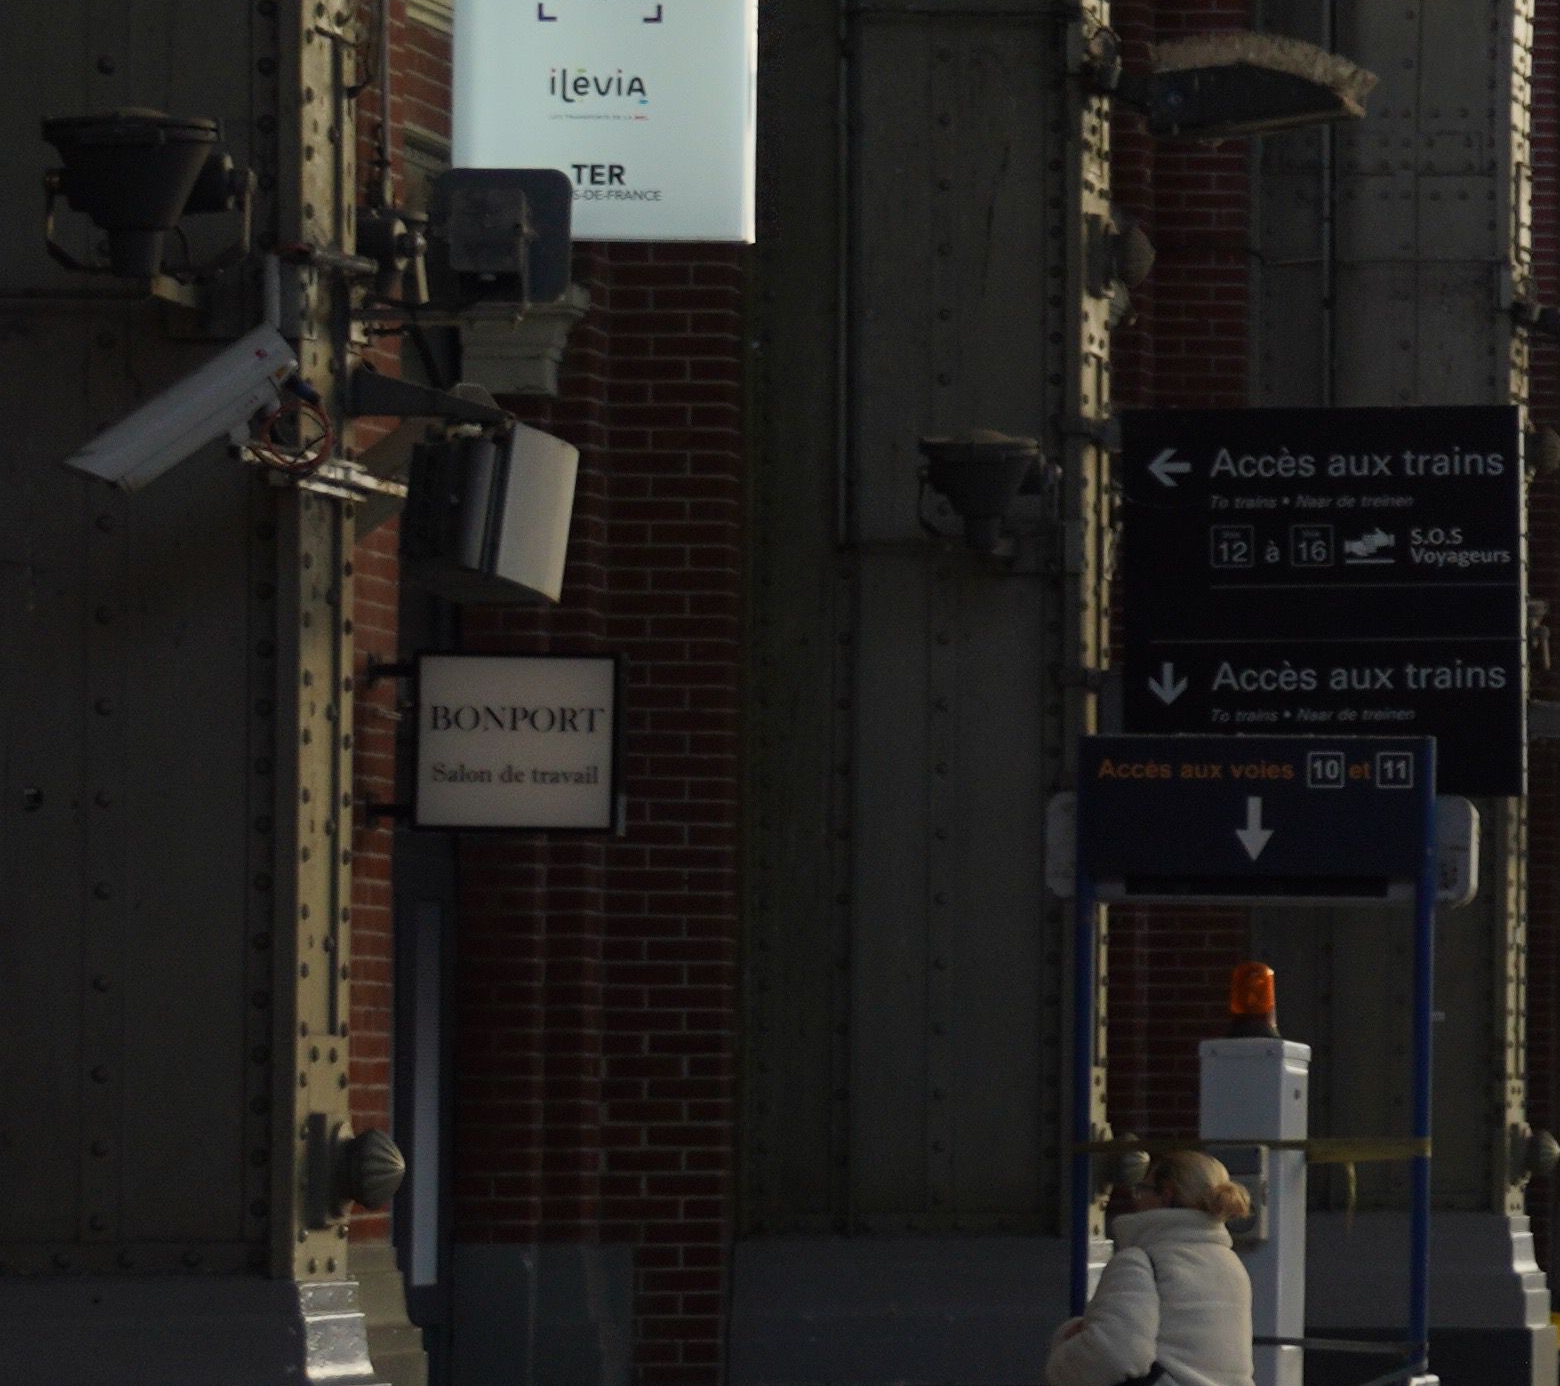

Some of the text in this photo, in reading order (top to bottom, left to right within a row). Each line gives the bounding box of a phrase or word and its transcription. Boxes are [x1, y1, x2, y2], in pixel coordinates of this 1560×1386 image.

[571, 164, 626, 186] TER
[573, 189, 662, 201] S-DE-FRANCE
[1210, 446, 1505, 477] Accès aux trains
[1211, 494, 1229, 508] To
[1235, 495, 1277, 509] trains
[1411, 527, 1463, 546] S.O.S
[1220, 540, 1327, 563] 12 à 16
[1411, 546, 1511, 568] Voyageurs
[1212, 659, 1506, 691] Accès aux trains
[431, 705, 604, 733] BONPORT
[1236, 709, 1279, 722] trains
[432, 763, 599, 785] Salon de travail
[1180, 764, 1222, 779] aux
[1230, 760, 1294, 779] voies
[1313, 760, 1340, 779] 10
[1348, 761, 1371, 779] et
[1384, 760, 1406, 779] 11
